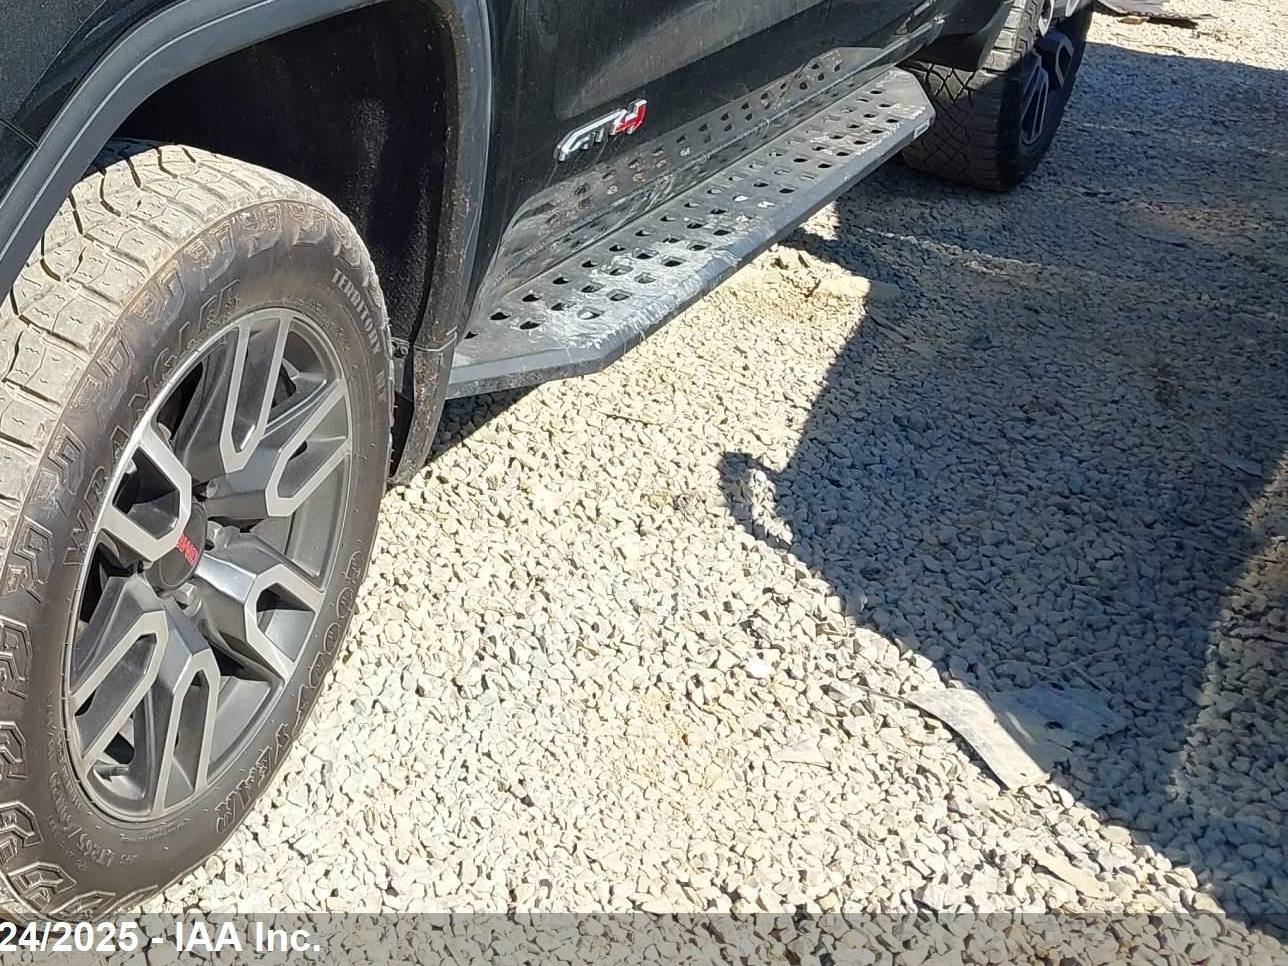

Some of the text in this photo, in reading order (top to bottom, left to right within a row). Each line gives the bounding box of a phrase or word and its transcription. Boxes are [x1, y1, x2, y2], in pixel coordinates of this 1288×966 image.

[63, 278, 242, 568] WRANGLER
[330, 267, 382, 354] TERRITORY
[215, 550, 365, 836] GOODYEAR
